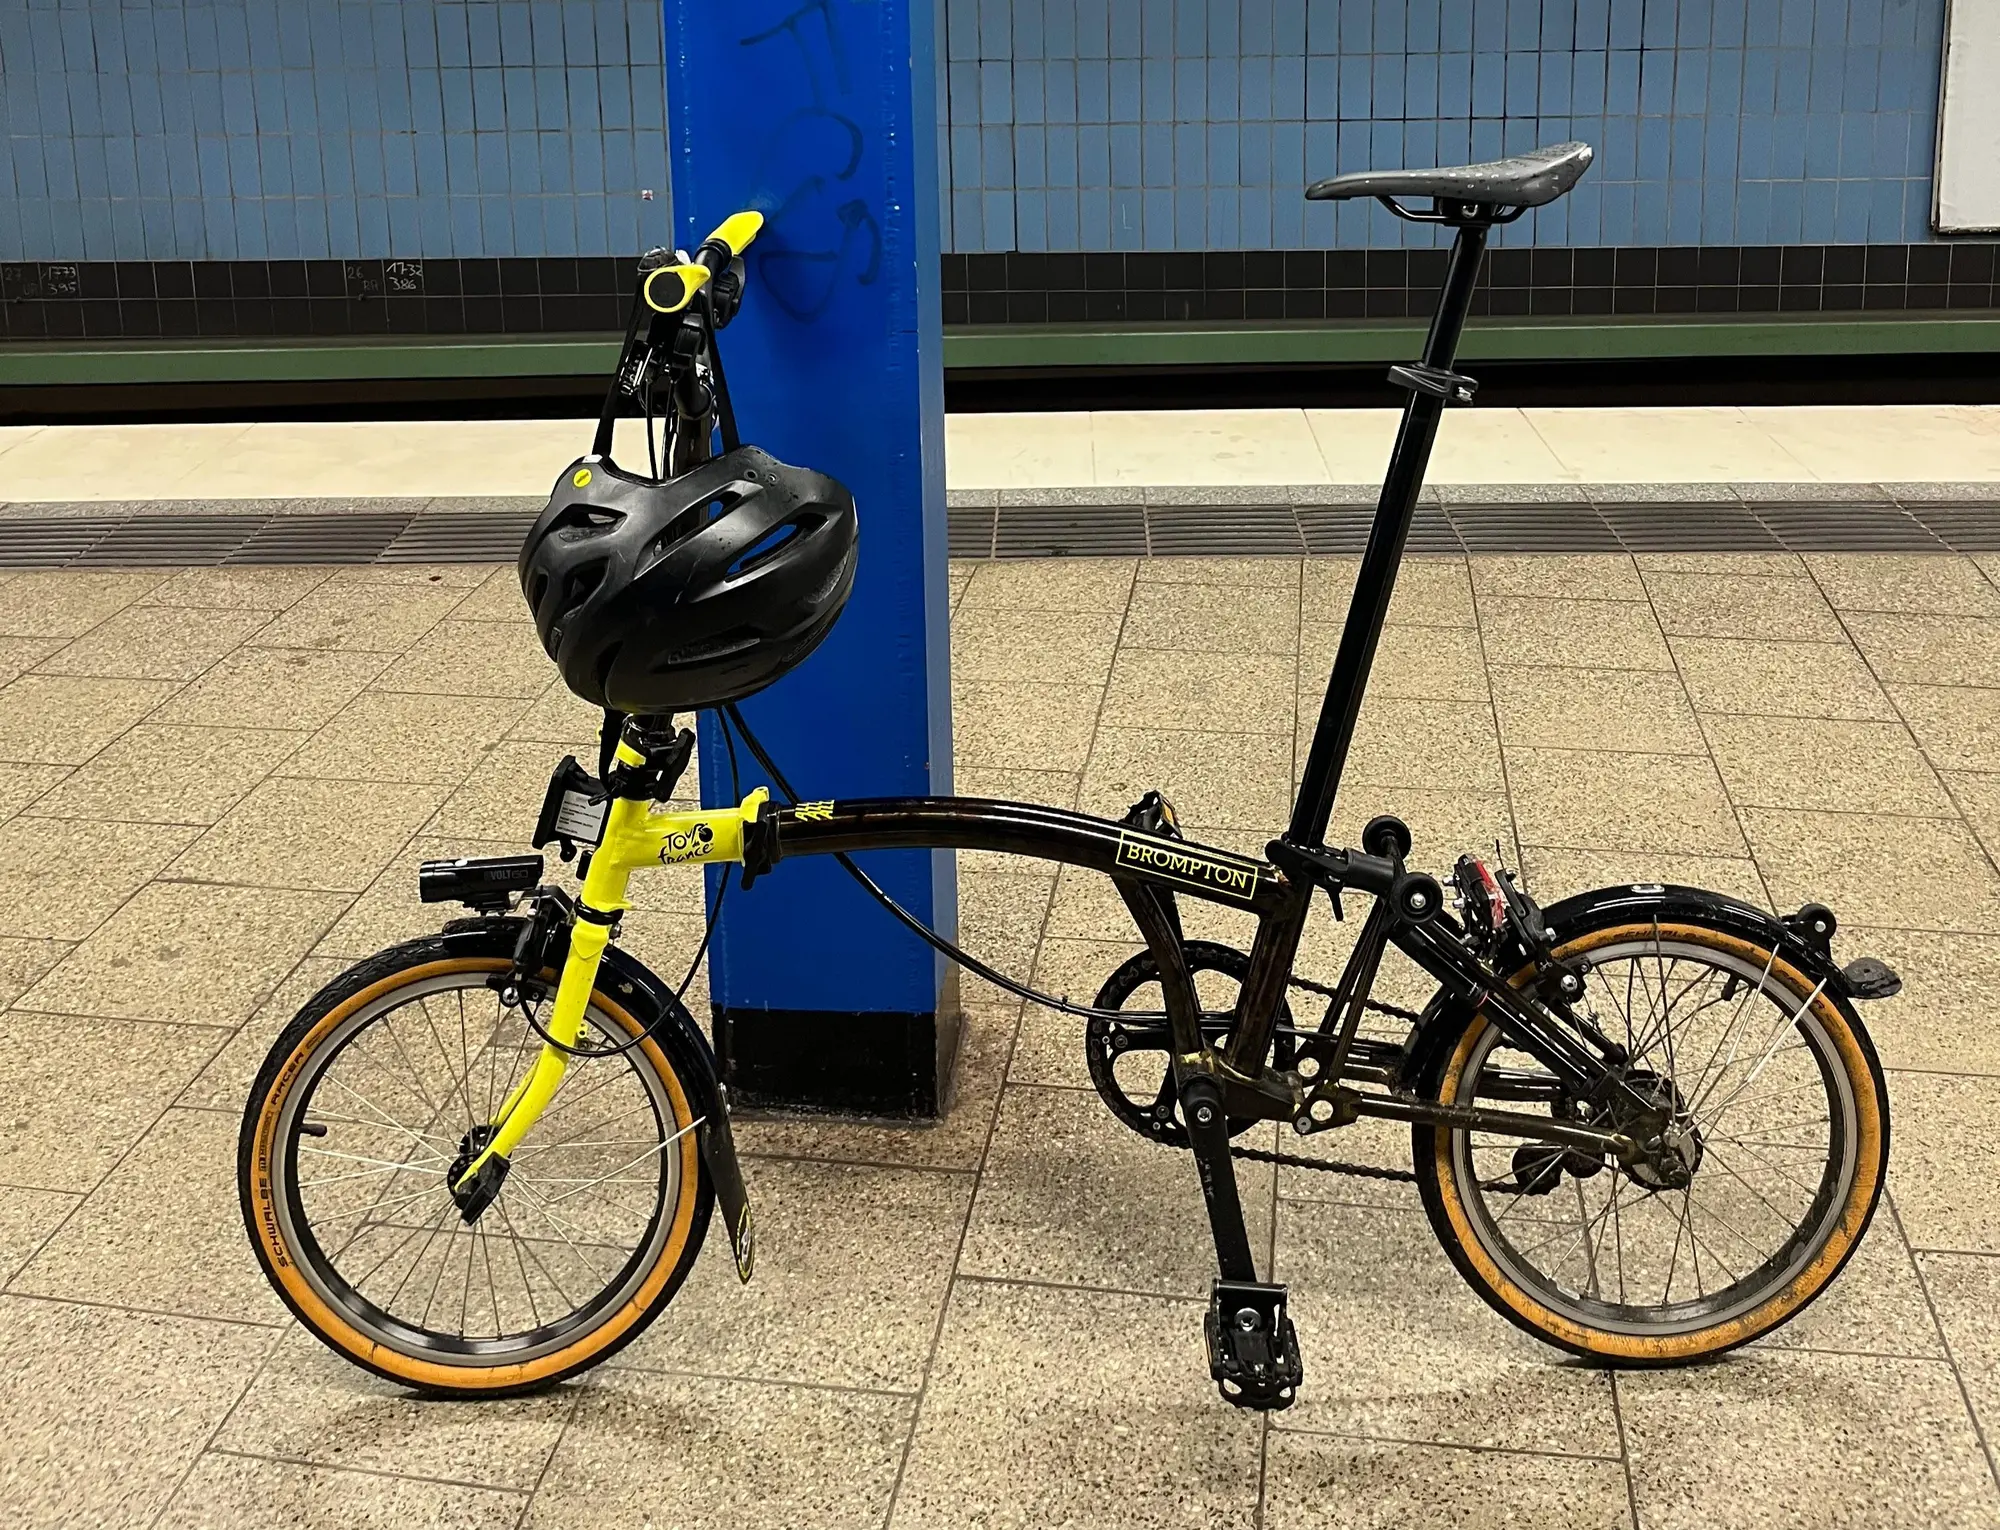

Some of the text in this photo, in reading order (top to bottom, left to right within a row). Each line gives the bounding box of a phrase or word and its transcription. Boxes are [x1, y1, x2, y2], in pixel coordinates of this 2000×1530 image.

[389, 277, 416, 291] 386
[1127, 843, 1248, 889] BROMPTON
[271, 1051, 304, 1105] RACER
[258, 1177, 288, 1268] SCHWALBE
